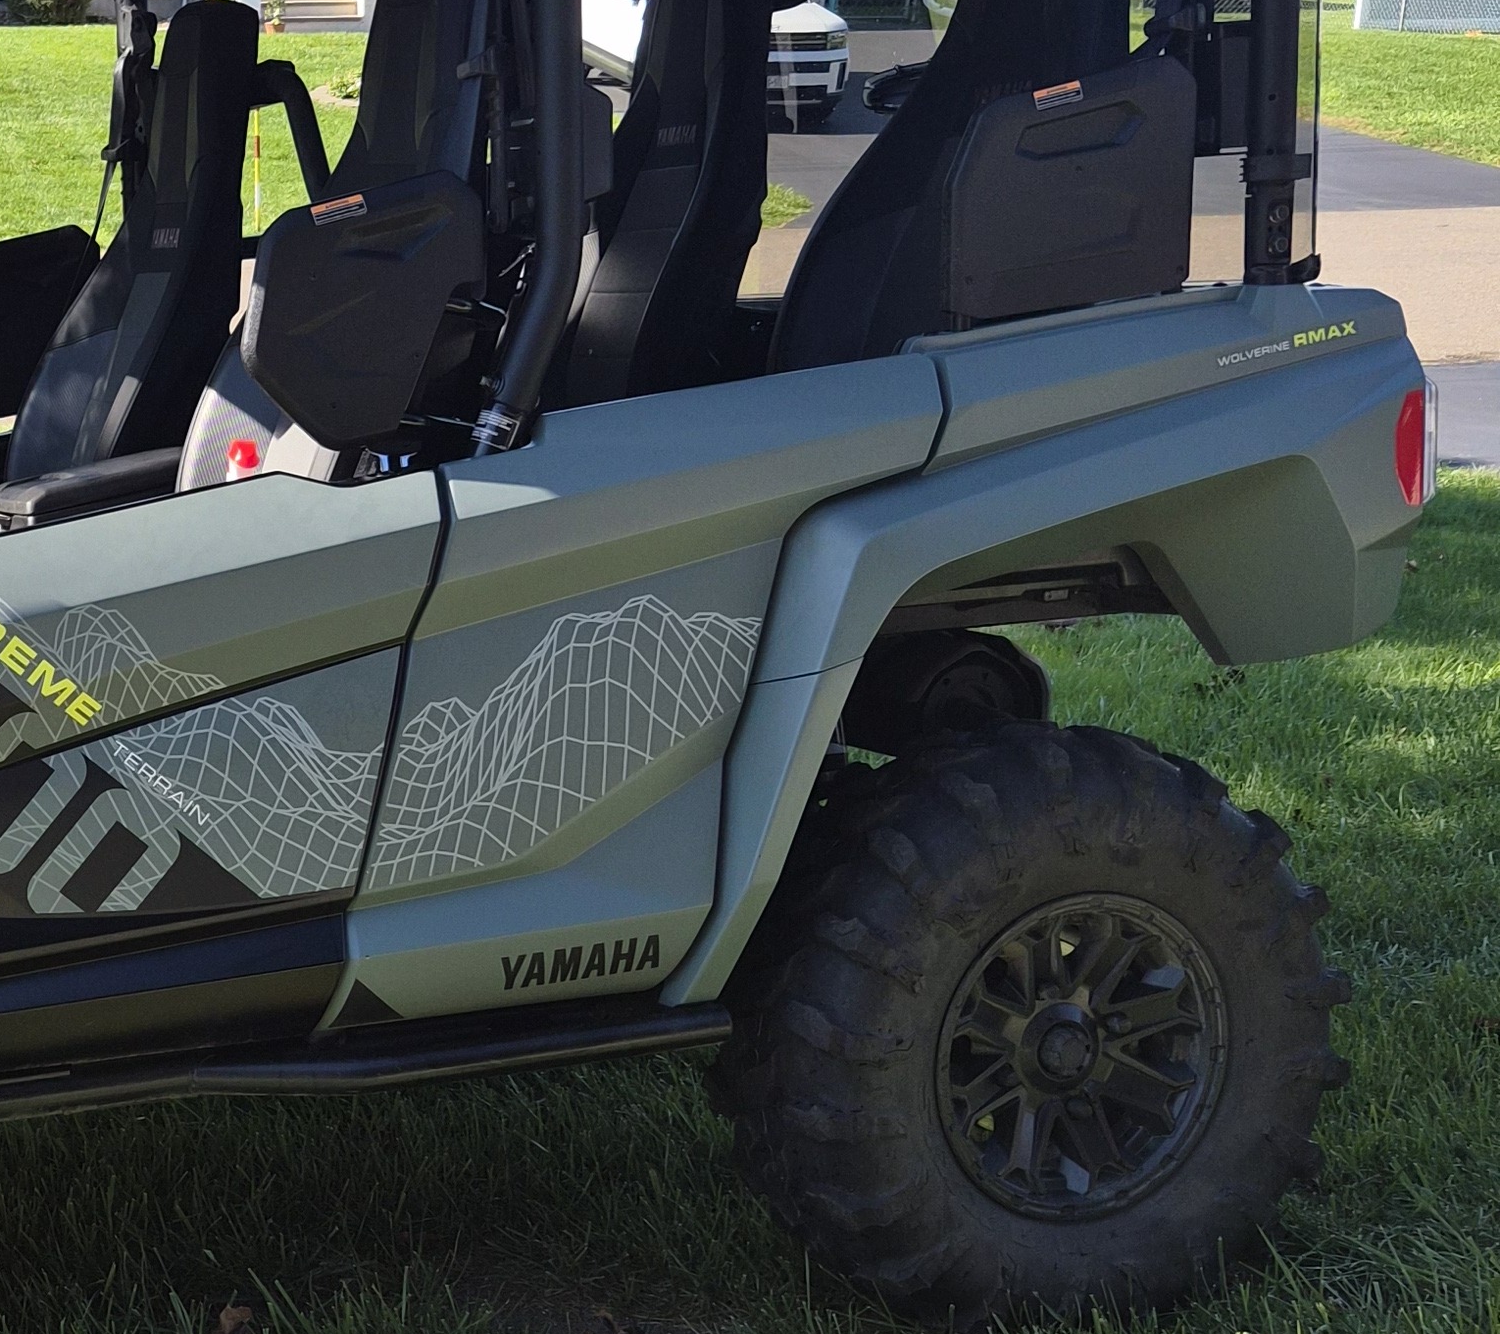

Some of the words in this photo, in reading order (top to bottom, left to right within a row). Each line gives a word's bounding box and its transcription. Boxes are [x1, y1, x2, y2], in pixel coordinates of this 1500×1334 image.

[1217, 340, 1290, 367] WOLVERINE
[1293, 320, 1357, 348] RMAX
[112, 739, 212, 827] TERRAIN
[500, 934, 660, 991] YAMAHA
